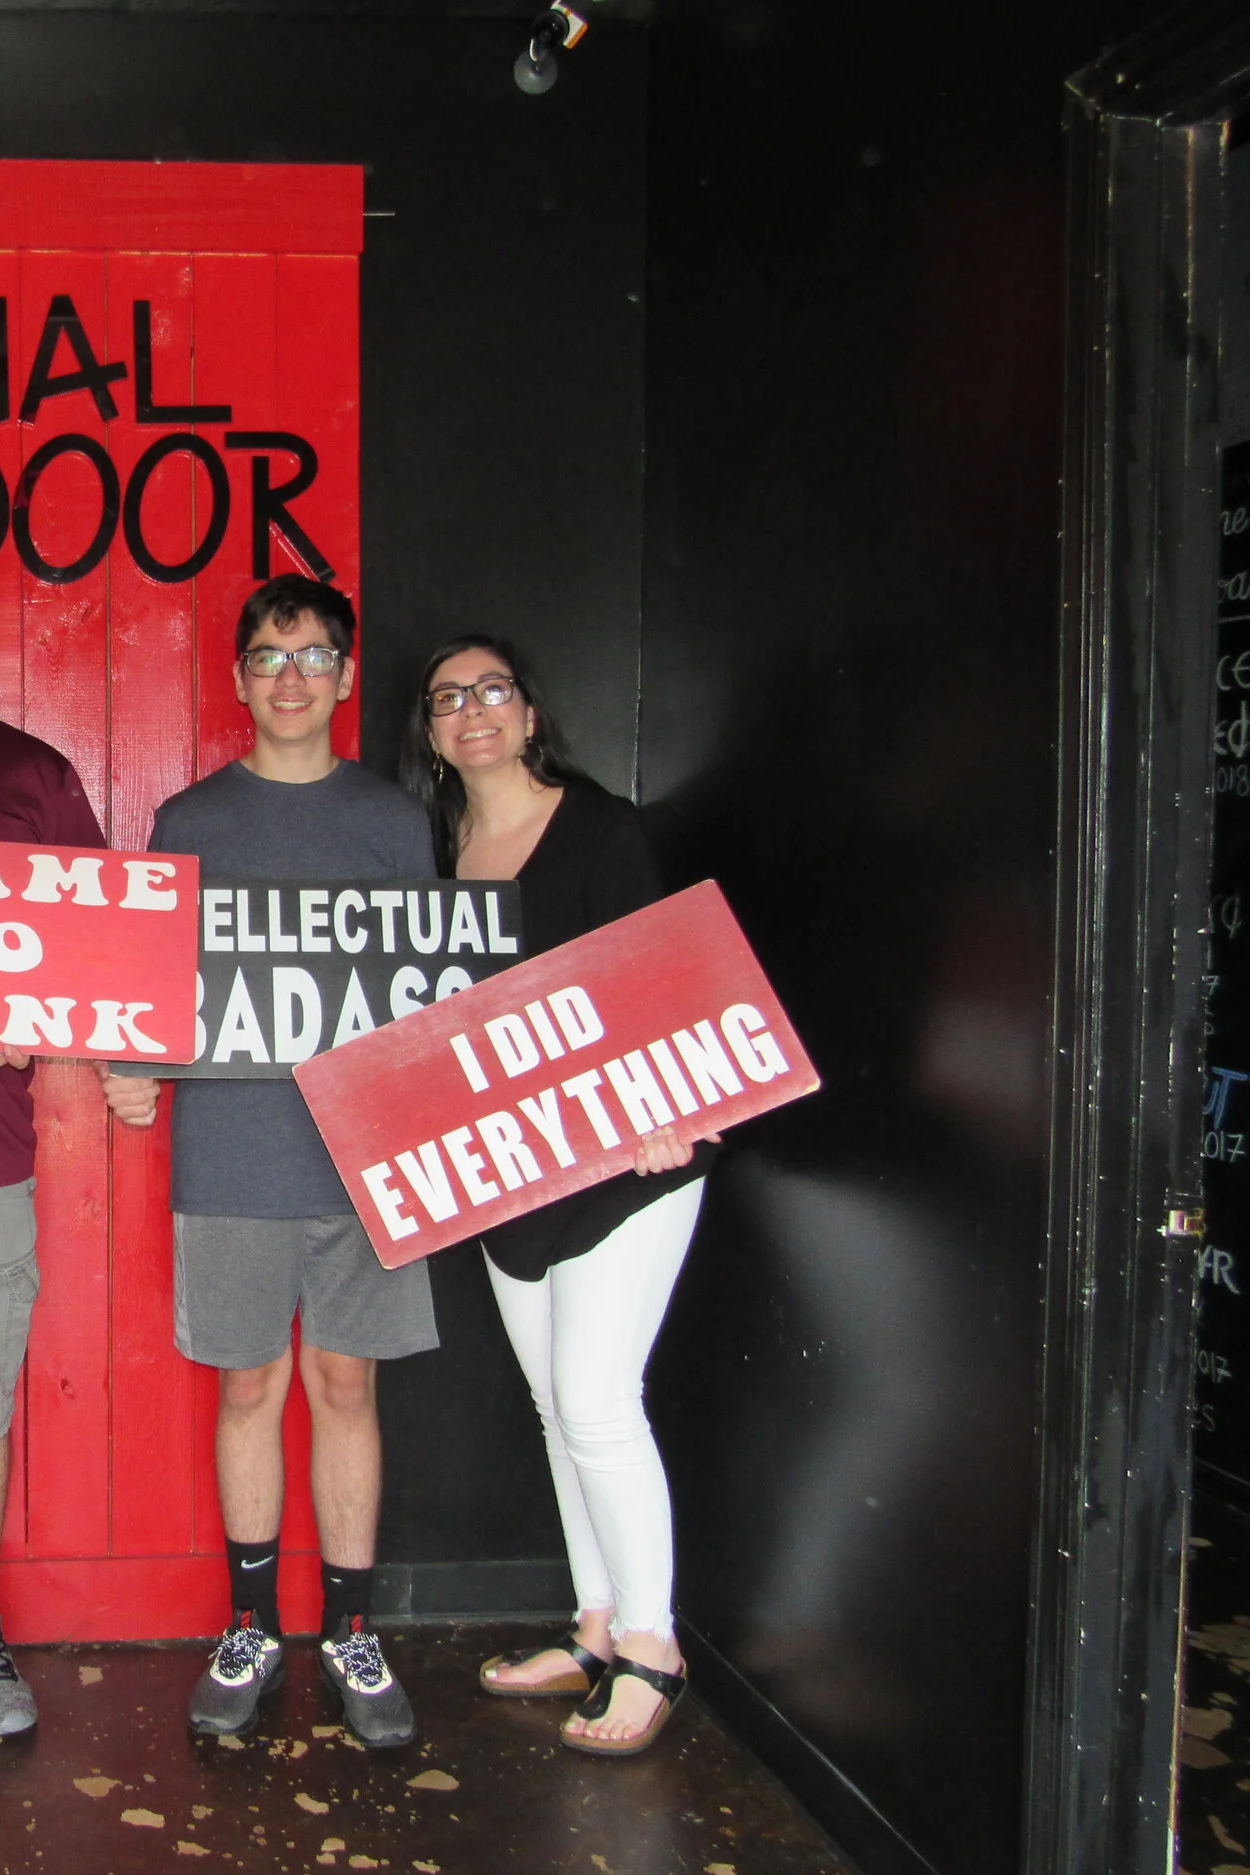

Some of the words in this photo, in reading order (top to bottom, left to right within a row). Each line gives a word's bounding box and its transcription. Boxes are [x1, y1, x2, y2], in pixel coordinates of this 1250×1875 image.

[1217, 764, 1250, 796] 018
[198, 889, 518, 955] ELLECTUAL
[195, 965, 474, 1064] ADA
[450, 1033, 490, 1094] I
[484, 985, 605, 1079] DID
[360, 1003, 790, 1242] EVERYTHING
[1204, 1131, 1246, 1163] 017
[1198, 1350, 1233, 1384] 017
